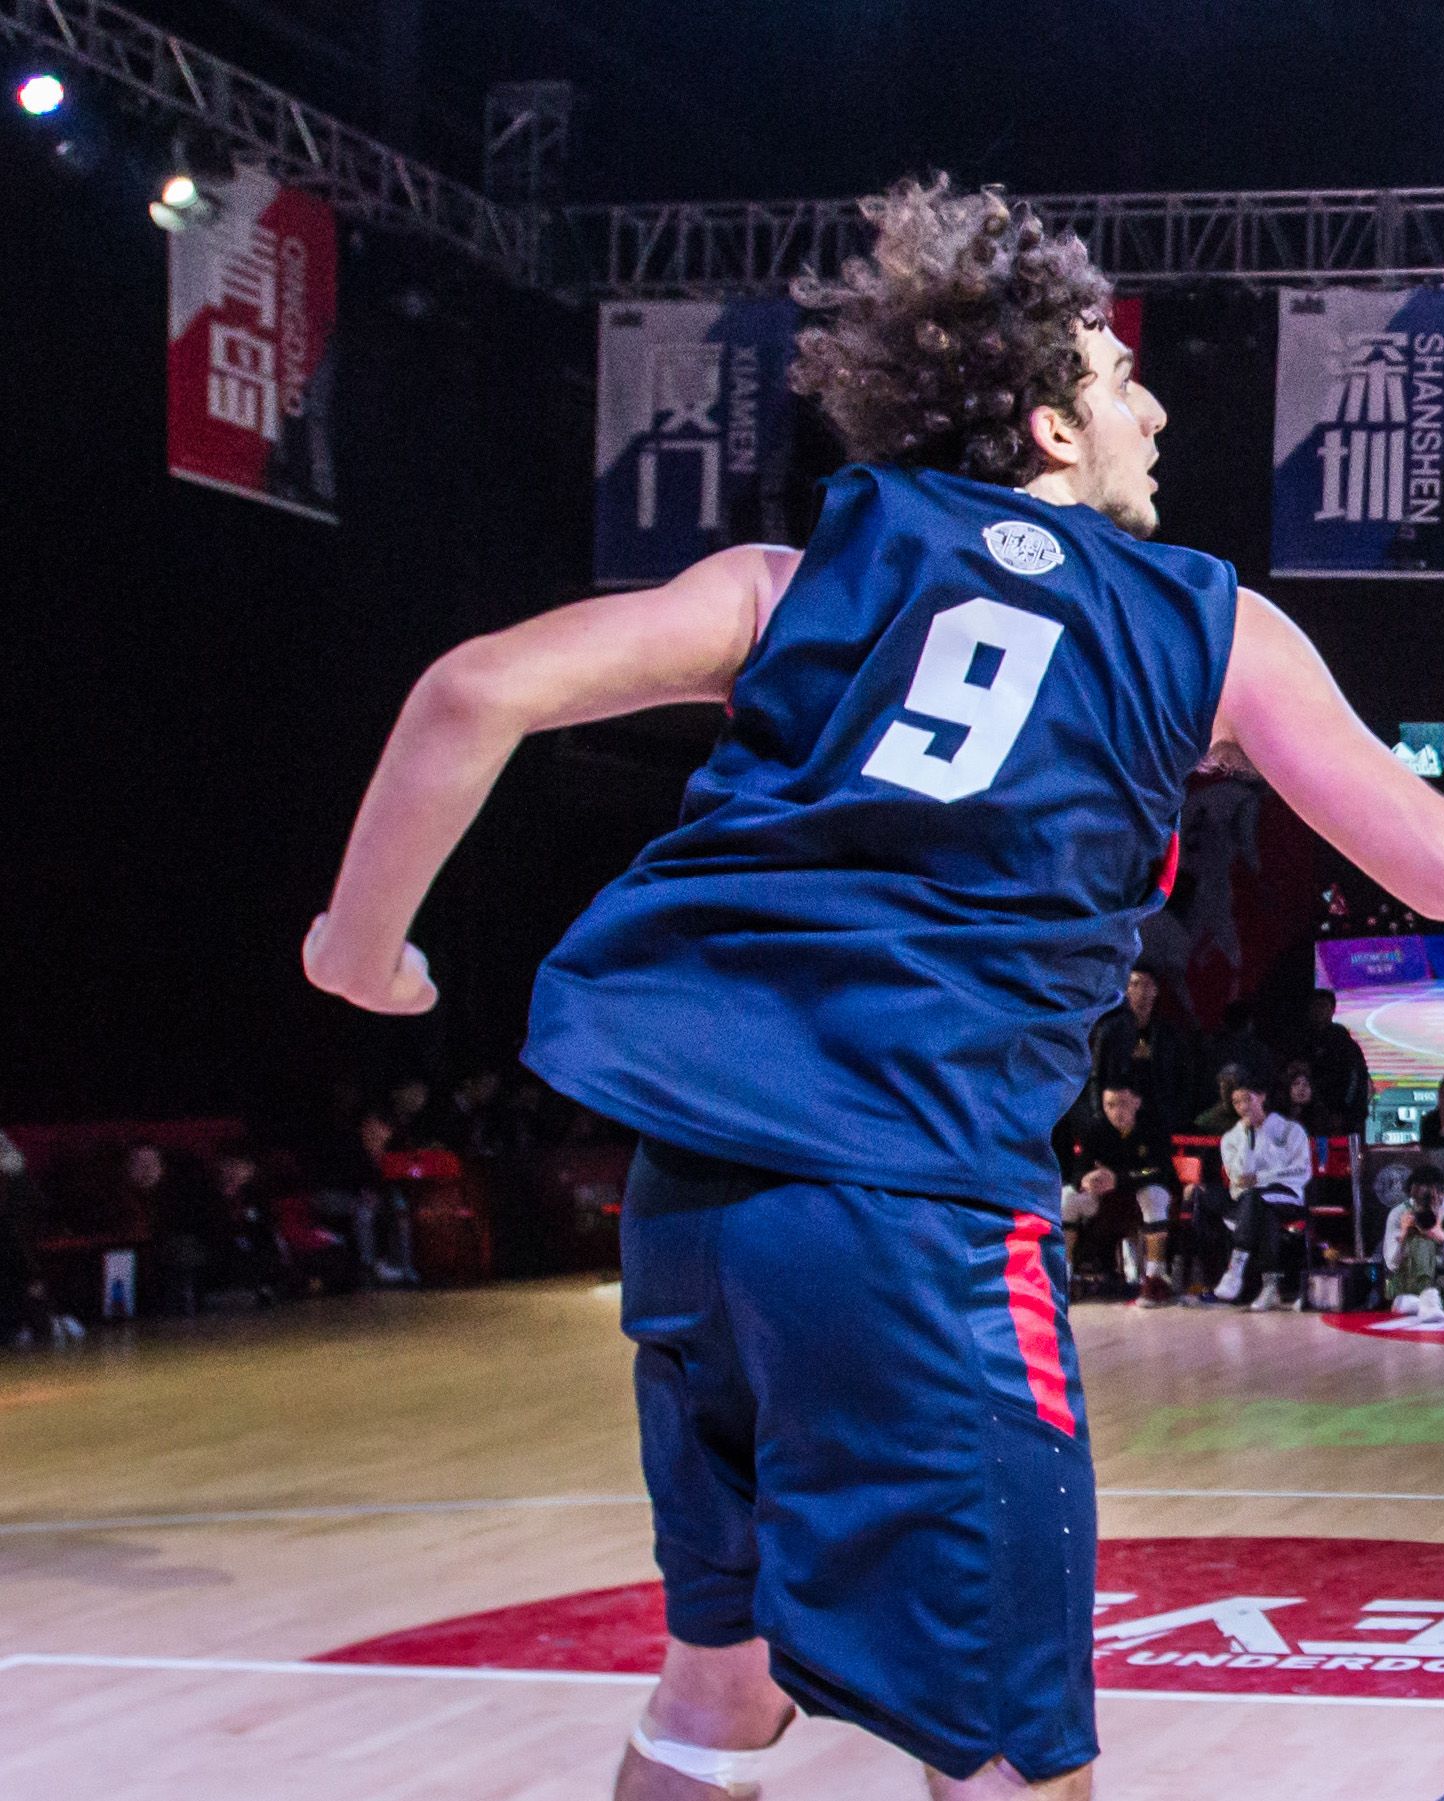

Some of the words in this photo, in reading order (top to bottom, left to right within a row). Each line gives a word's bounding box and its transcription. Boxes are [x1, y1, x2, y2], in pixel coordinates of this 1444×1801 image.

[637, 341, 724, 529] 厦门
[728, 347, 758, 472] XIAMEN
[1314, 332, 1408, 521] 深圳
[861, 597, 1064, 804] 9
